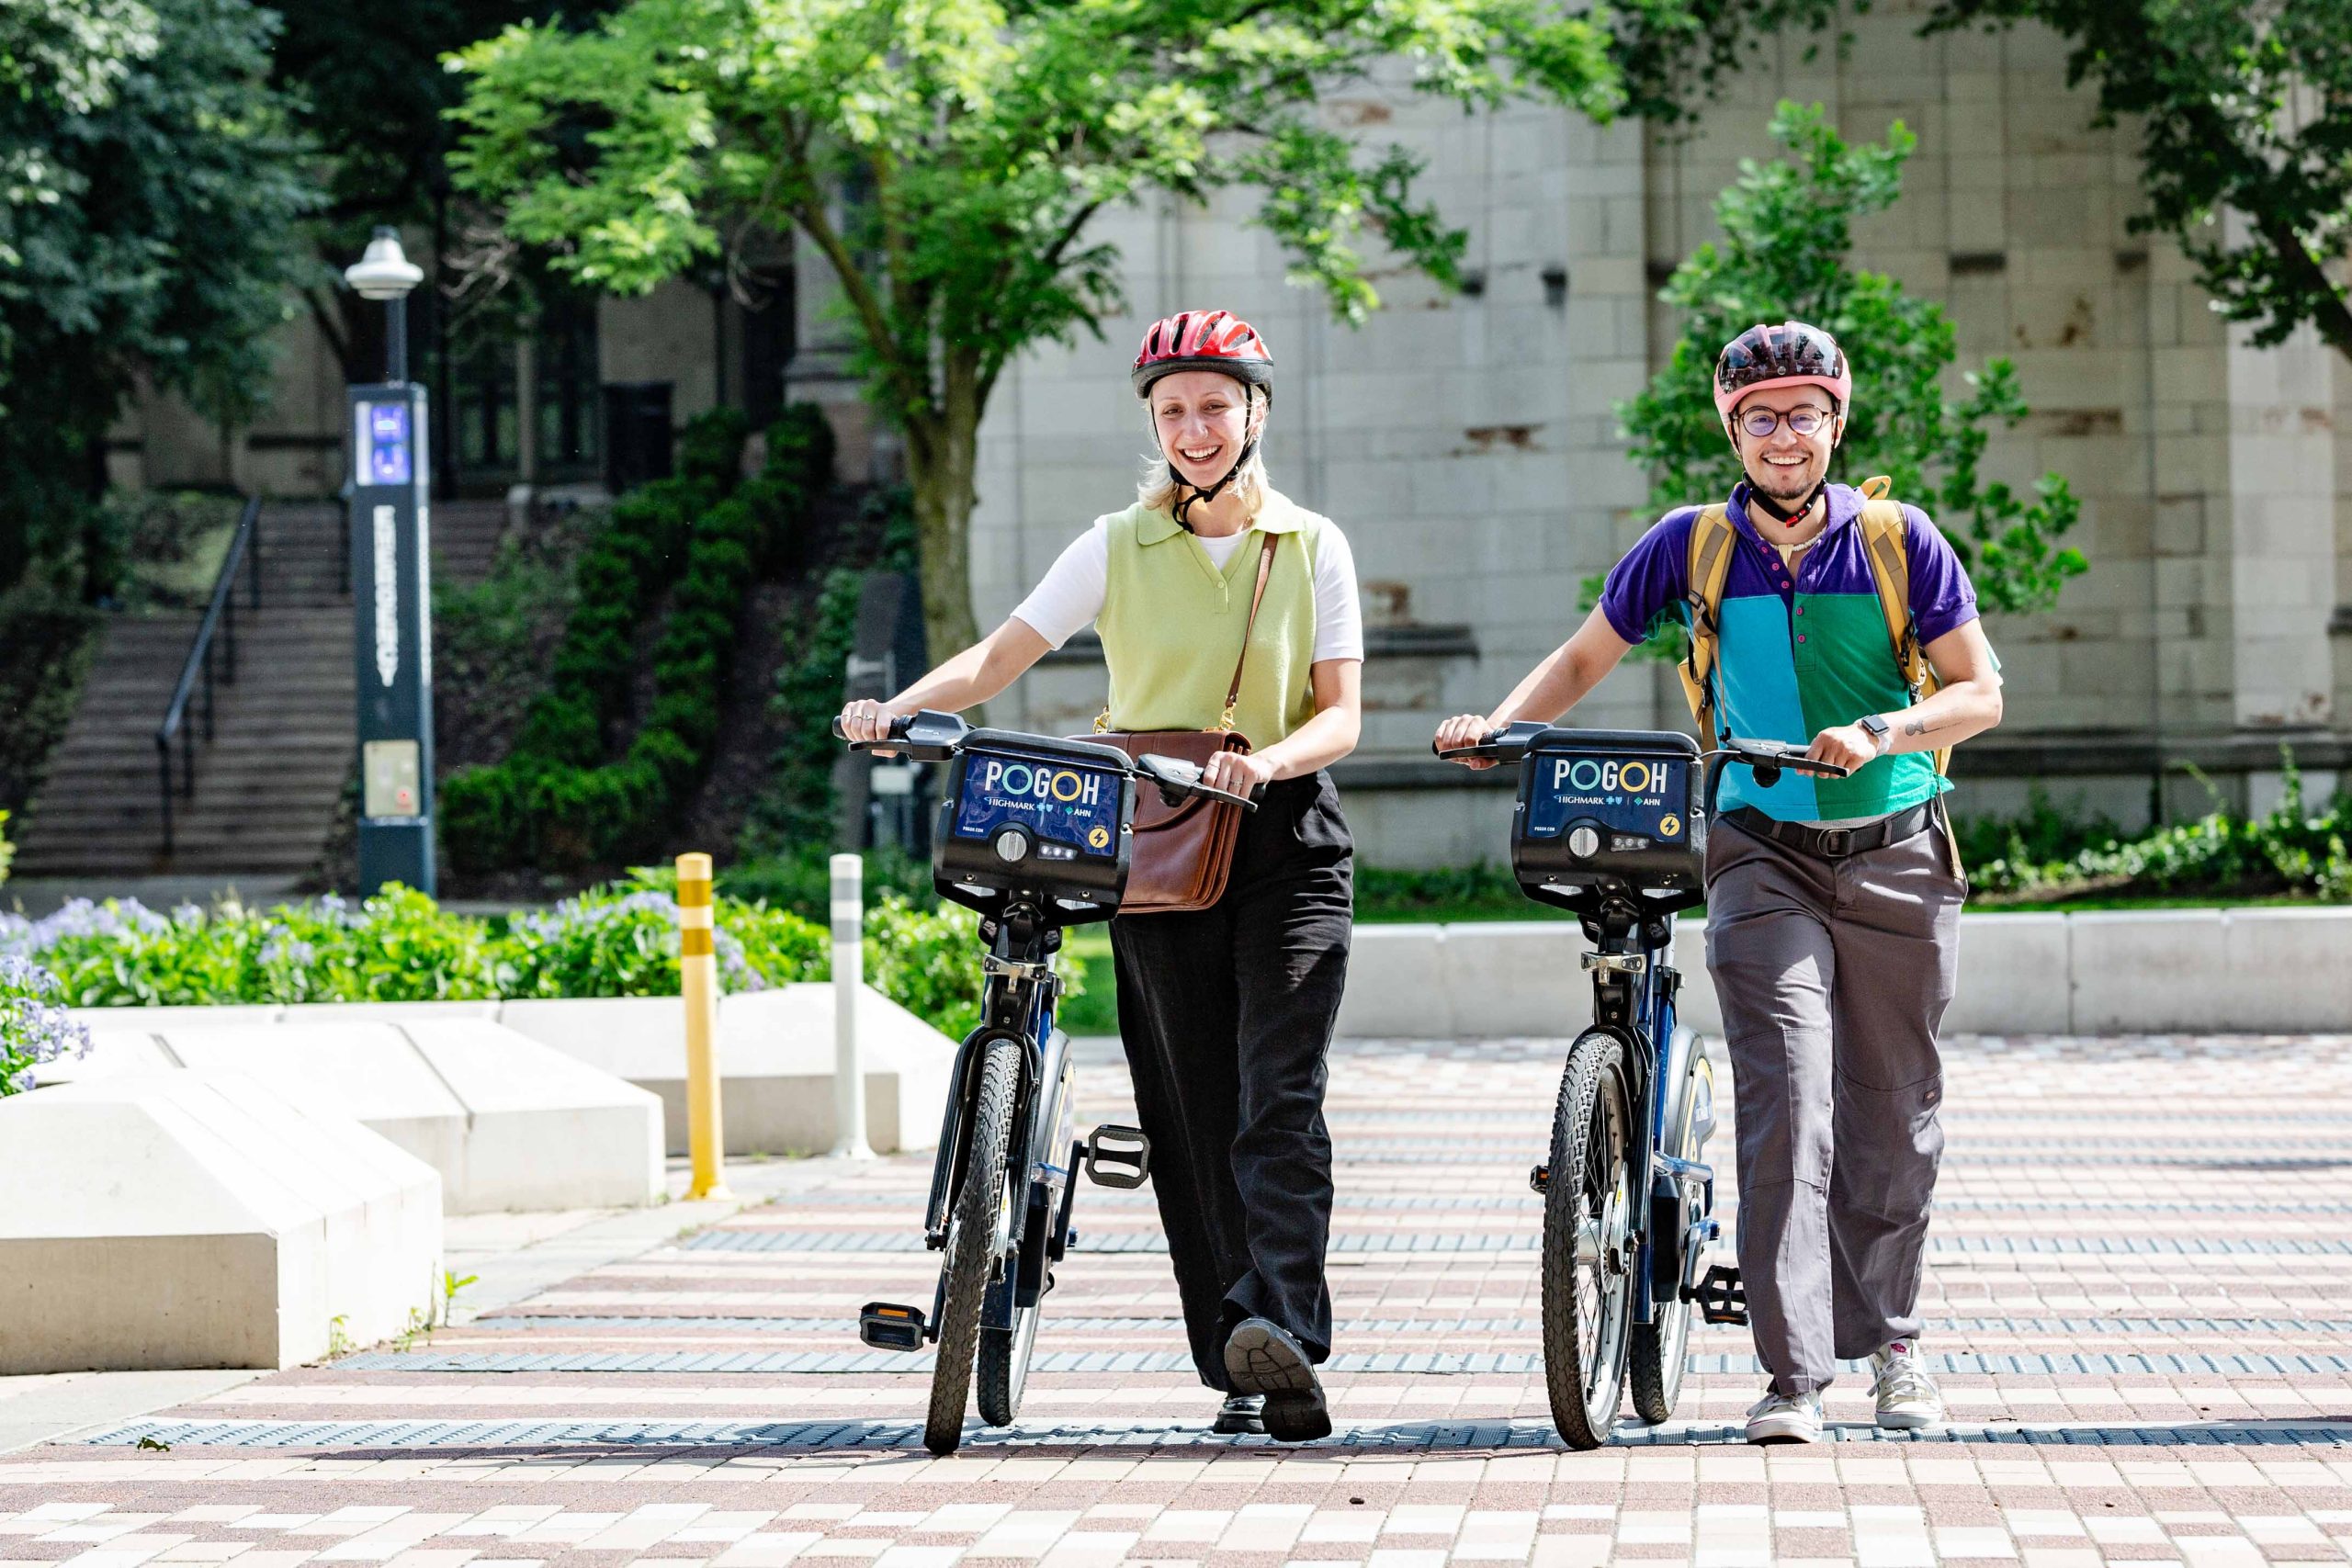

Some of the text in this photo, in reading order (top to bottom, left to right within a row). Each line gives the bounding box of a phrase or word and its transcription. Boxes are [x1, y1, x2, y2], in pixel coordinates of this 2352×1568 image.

[984, 761, 1100, 806] POGOH
[1554, 759, 1668, 794] POGOH
[987, 797, 1091, 818] HIGHMARK AHN
[1556, 795, 1660, 807] HIGHMARK AHN
